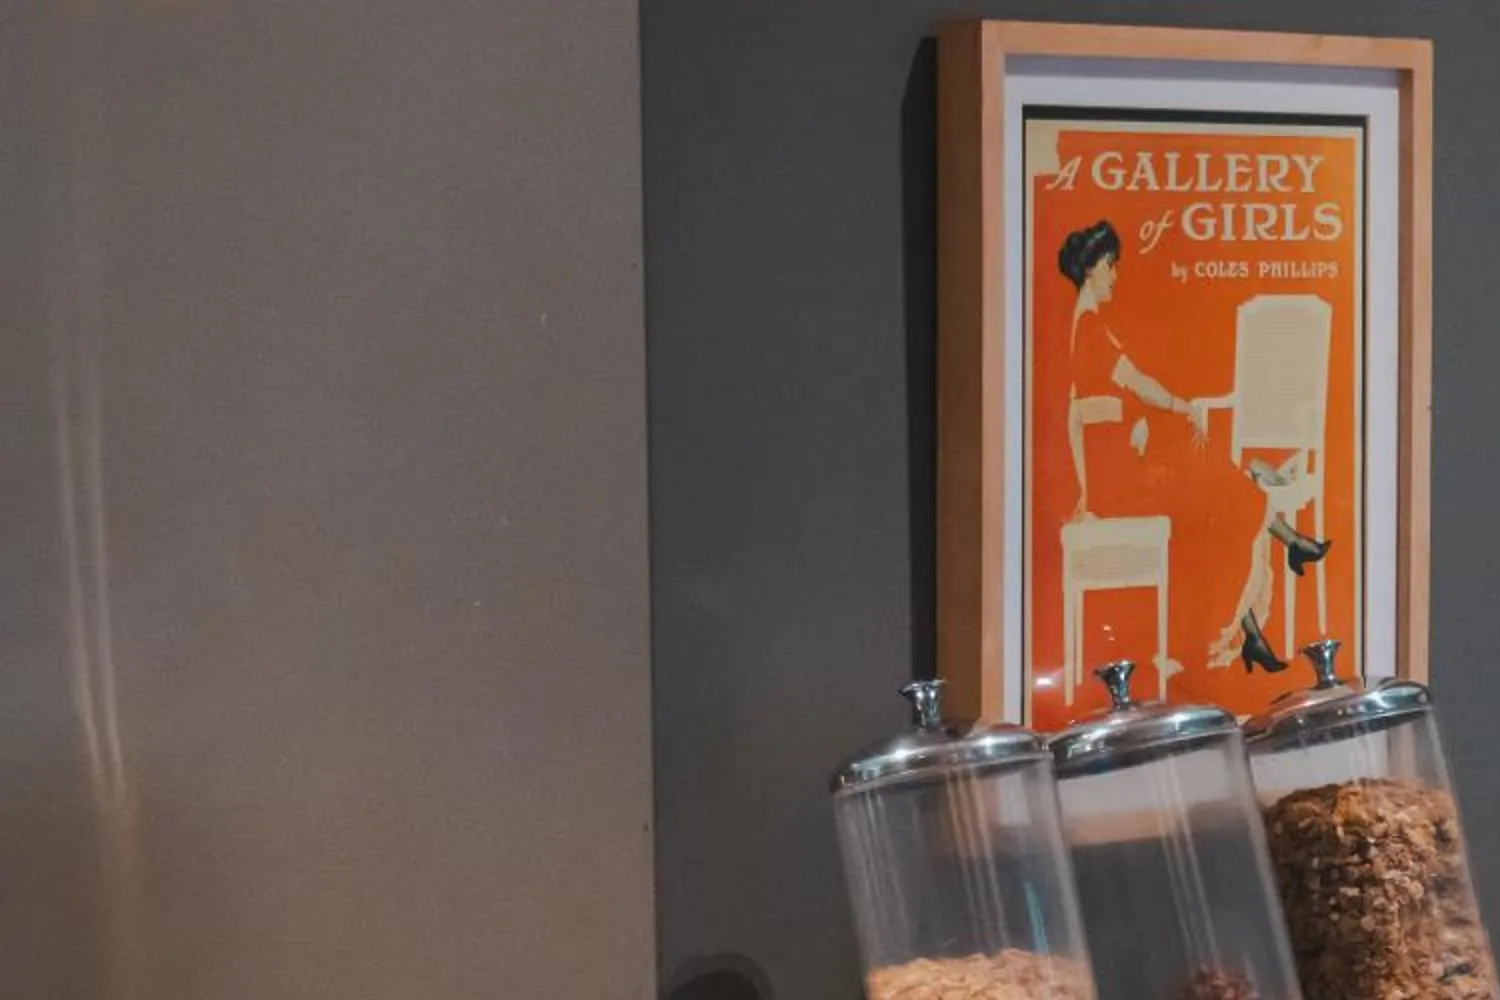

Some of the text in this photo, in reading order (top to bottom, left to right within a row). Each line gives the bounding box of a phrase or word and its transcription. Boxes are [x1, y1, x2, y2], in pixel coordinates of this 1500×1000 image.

[1046, 150, 1324, 193] A GALLERY
[1138, 202, 1344, 255] of GIRLS
[1171, 260, 1340, 283] by COLES PHILLIPS
